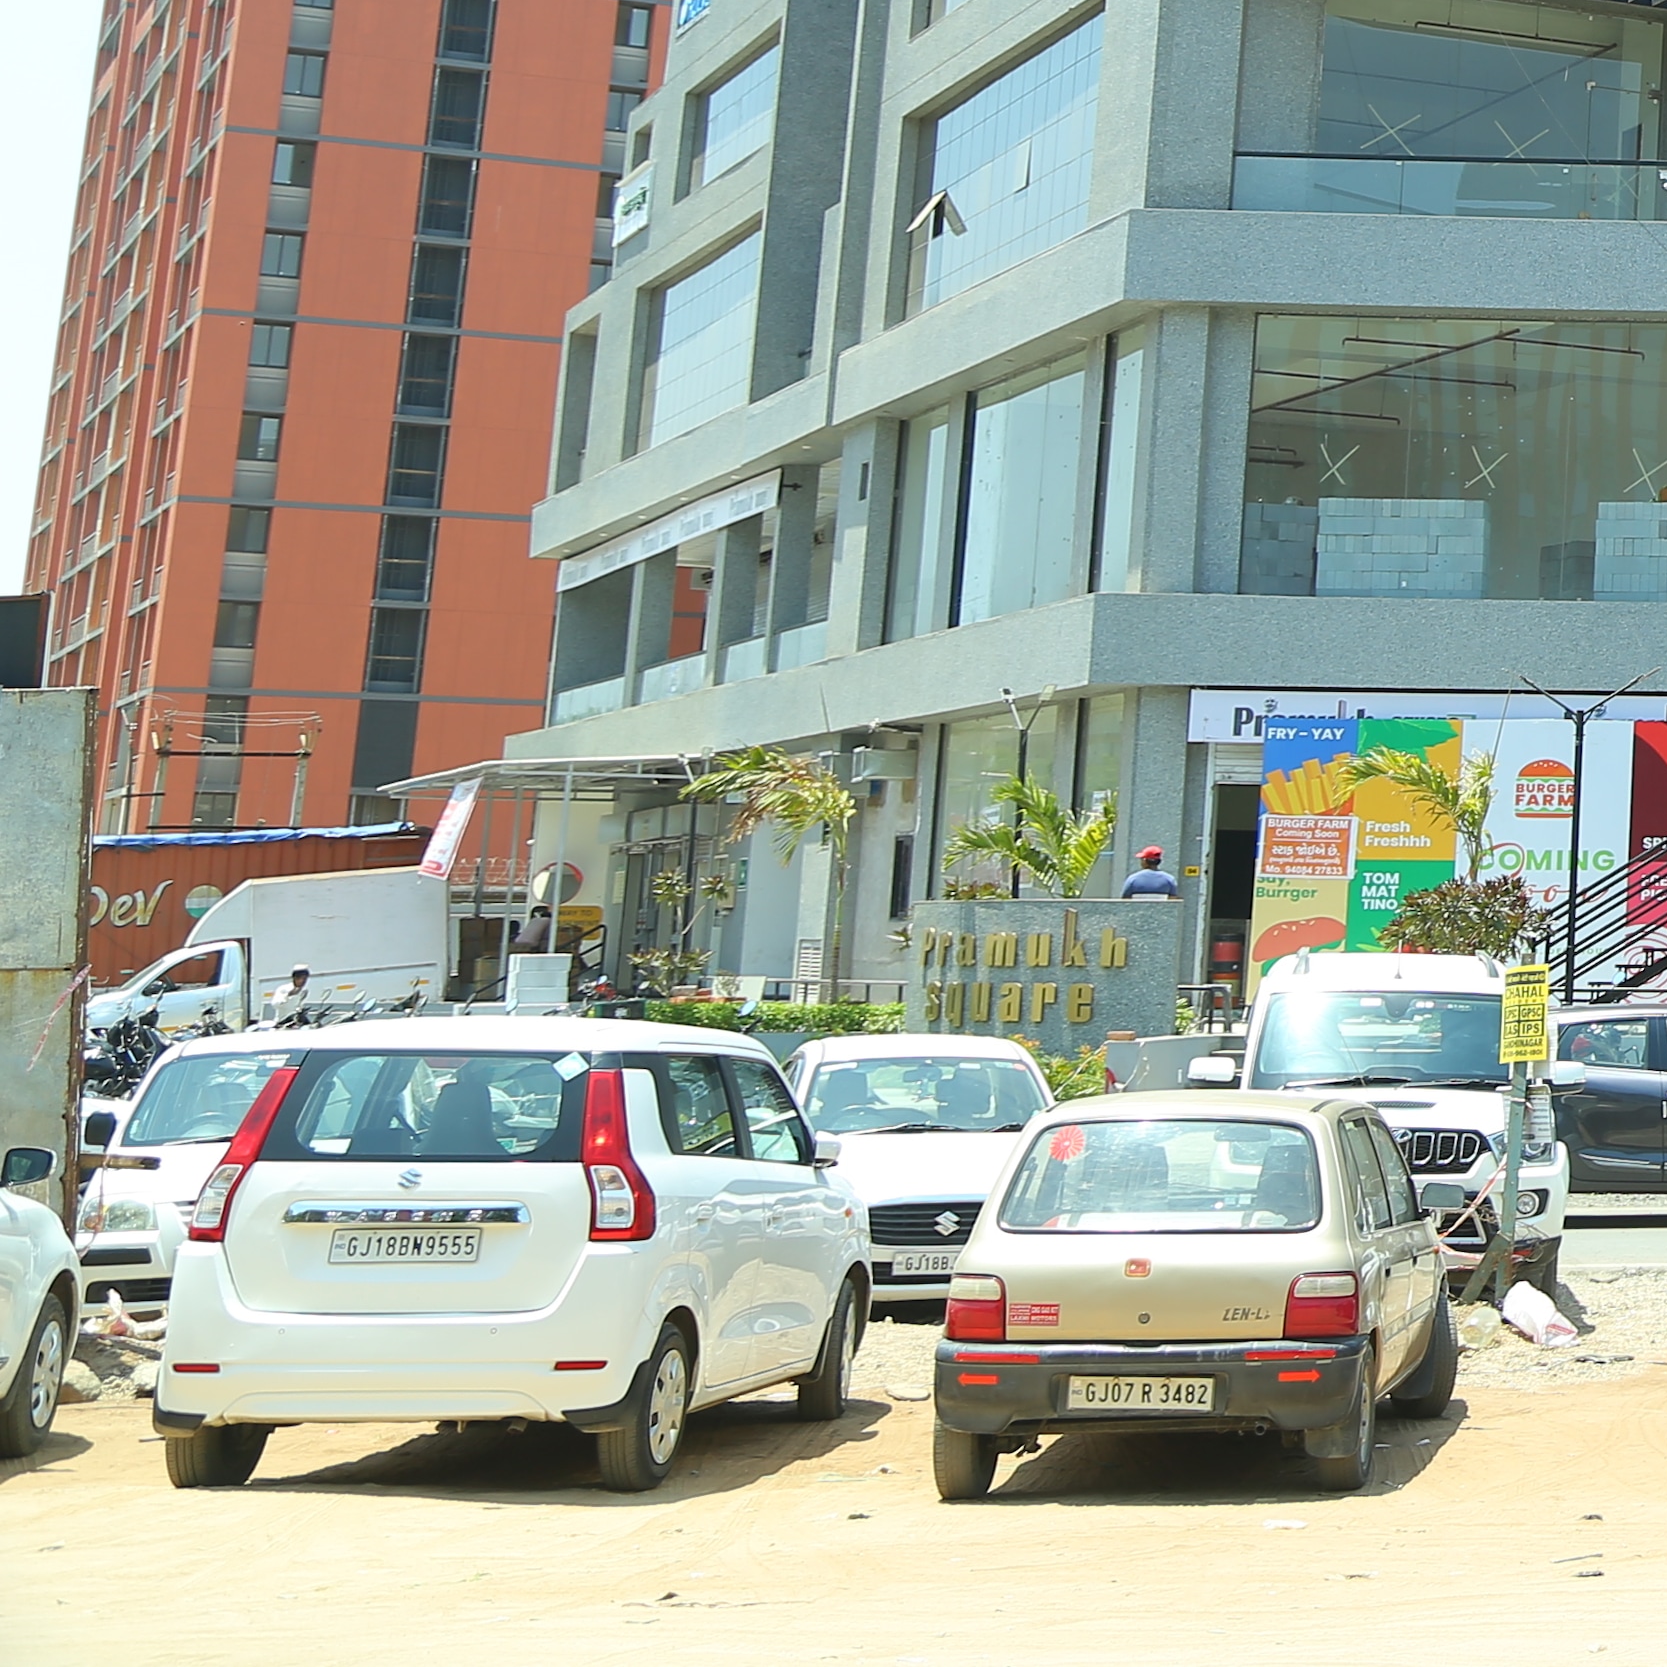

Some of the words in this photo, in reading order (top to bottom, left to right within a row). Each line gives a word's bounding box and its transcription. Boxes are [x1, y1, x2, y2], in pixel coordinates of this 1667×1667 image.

[1267, 727, 1295, 740] FRY
[1312, 727, 1344, 741] YAY
[1515, 784, 1574, 793] BURGER
[1515, 794, 1574, 806] FARM
[1268, 818, 1315, 828] BURGER
[1317, 819, 1348, 829] FARM
[1366, 820, 1410, 833] Fresh
[1276, 828, 1312, 838] Coming
[1314, 829, 1339, 838] Soon
[1365, 834, 1430, 847] Freshhh
[1477, 849, 1615, 871] COMING
[1265, 865, 1282, 873] Mo.
[1362, 872, 1399, 884] TOM
[1256, 887, 1317, 902] Burrger
[1361, 885, 1397, 897] MAT
[1361, 898, 1398, 911] TINO
[922, 908, 1127, 969] Pramukh
[1505, 985, 1544, 1000] CHAHAL
[925, 977, 1094, 1028] square
[1521, 1007, 1541, 1017] GPSC
[1522, 1023, 1540, 1034] IPS
[347, 1236, 476, 1257] GJ18BN9555
[905, 1256, 955, 1271] GJ18B
[1031, 1315, 1058, 1323] MOTORS
[1086, 1382, 1134, 1403] GJ07
[1142, 1383, 1152, 1403] R
[1159, 1383, 1208, 1404] 3482
